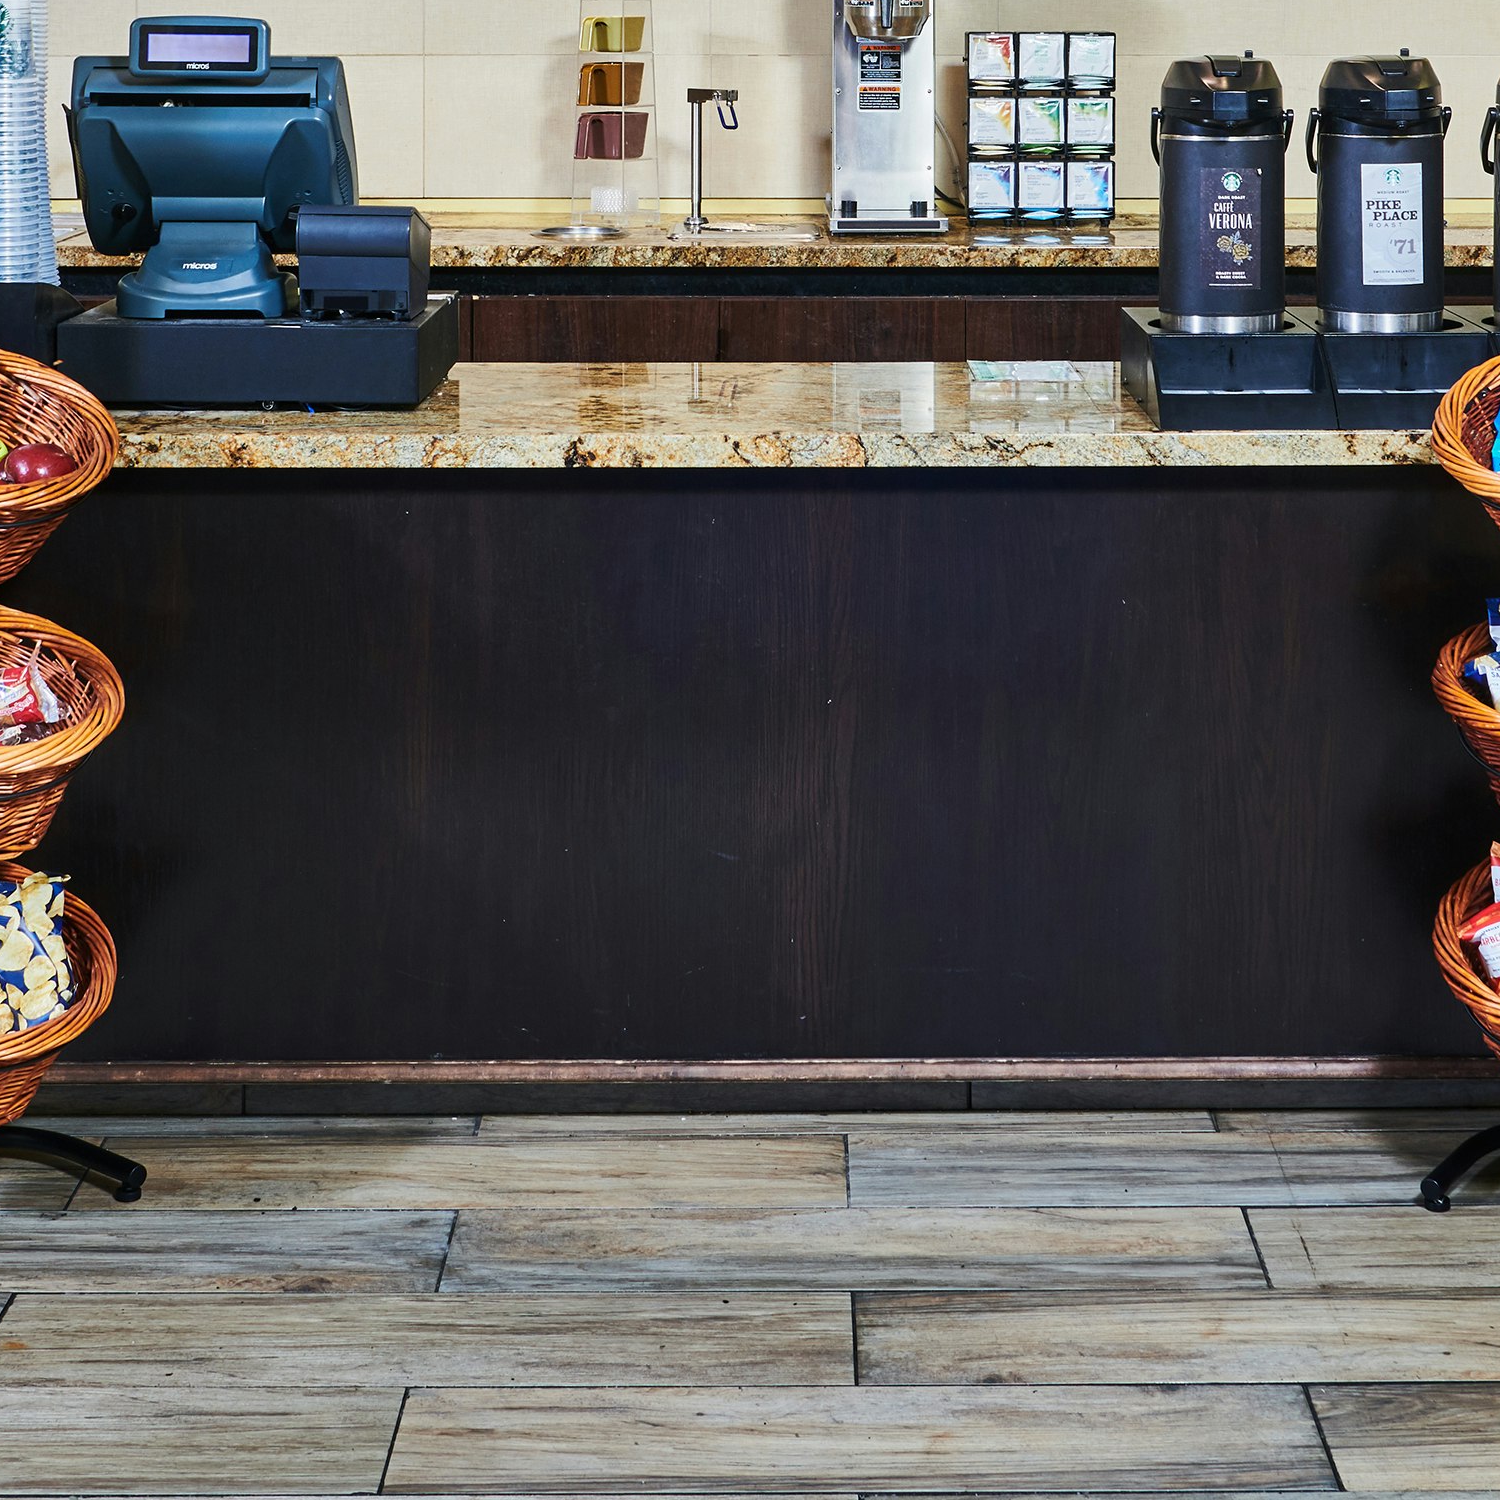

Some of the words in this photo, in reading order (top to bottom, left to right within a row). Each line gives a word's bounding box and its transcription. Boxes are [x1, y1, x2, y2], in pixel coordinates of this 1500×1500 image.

[186, 62, 210, 71] micros
[1365, 200, 1402, 211] PIKE
[1372, 211, 1419, 221] PLACE
[1208, 213, 1254, 230] VERONA
[182, 261, 218, 270] micros
